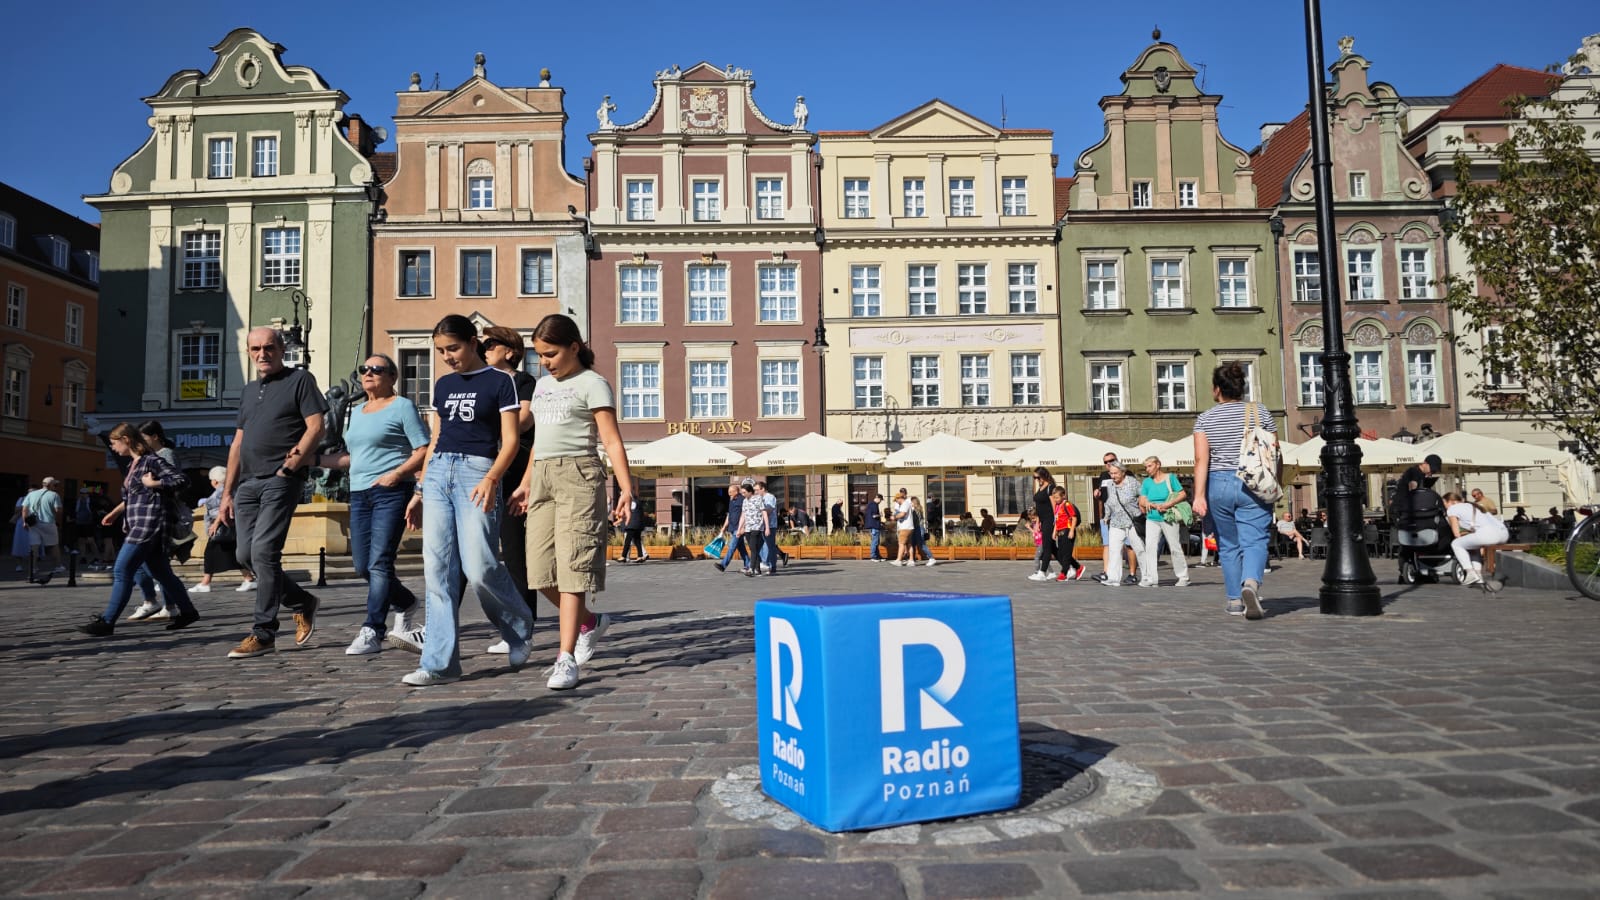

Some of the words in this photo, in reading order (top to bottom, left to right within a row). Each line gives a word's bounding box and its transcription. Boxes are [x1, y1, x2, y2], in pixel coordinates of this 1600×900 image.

[444, 399, 476, 422] 75
[176, 434, 221, 448] Pijalnia
[667, 422, 701, 435] BEE
[707, 421, 752, 434] JAY'S
[769, 616, 803, 731] R
[879, 617, 966, 733] R
[772, 731, 805, 771] Radio
[882, 738, 970, 775] Radio
[772, 763, 805, 796] Poznań
[883, 773, 970, 802] Poznań
